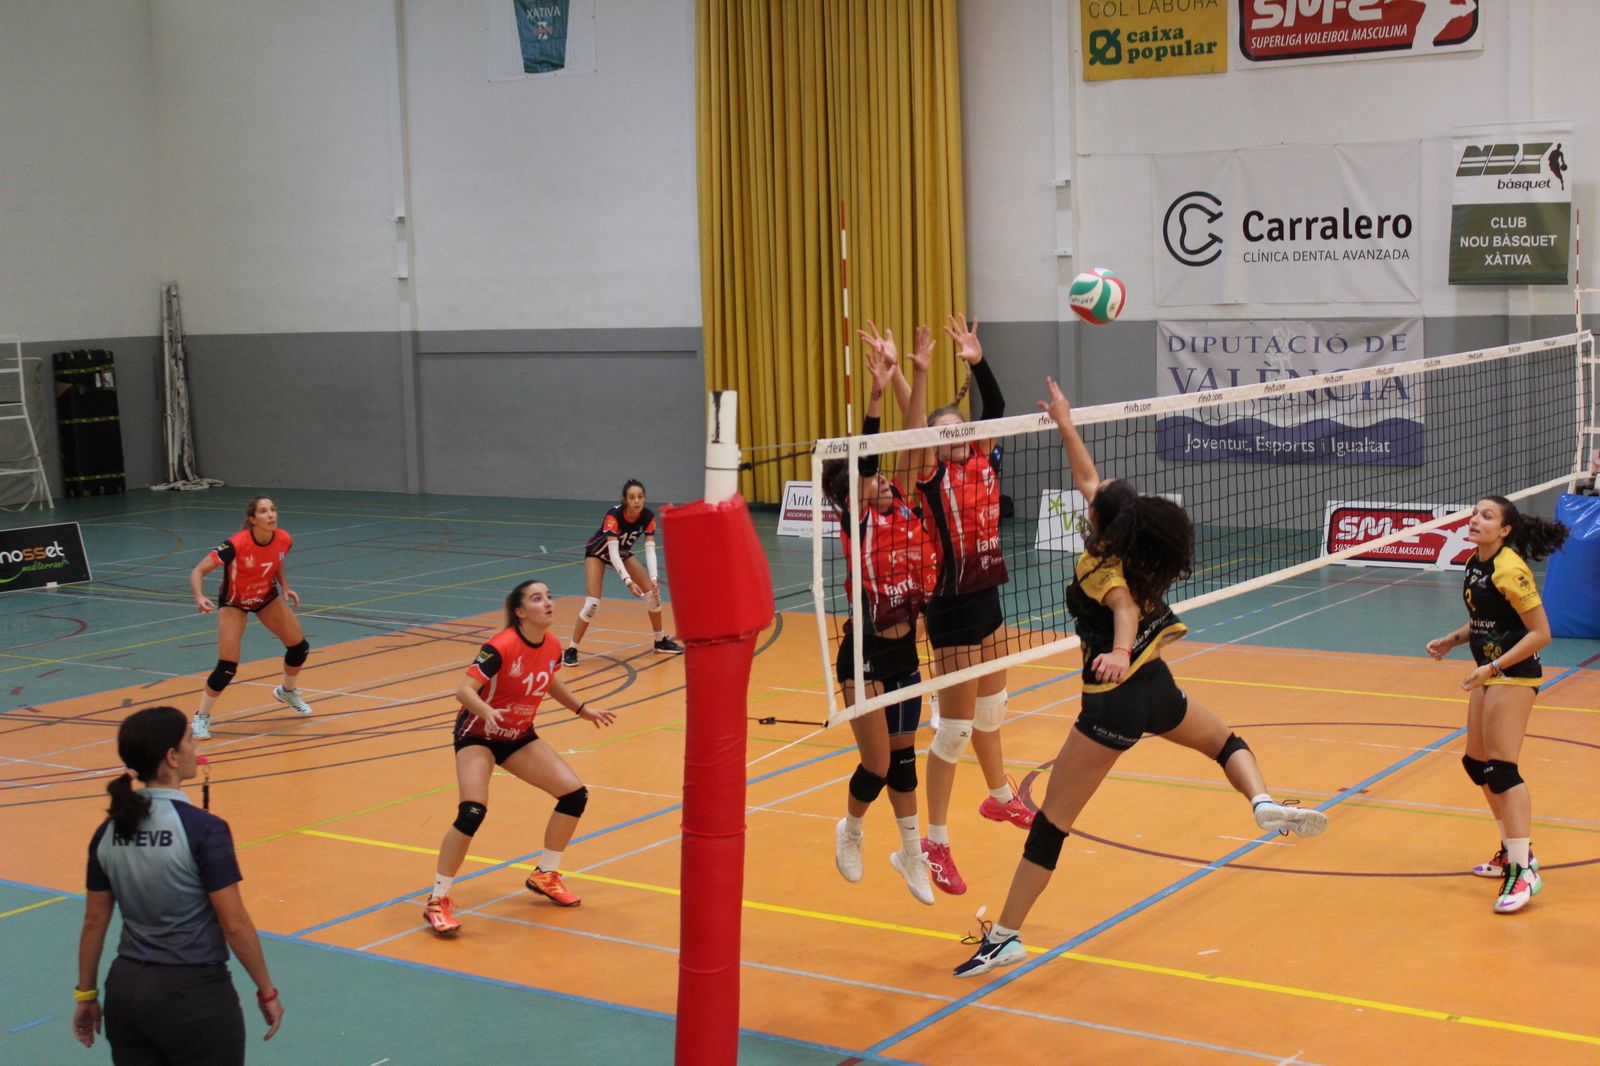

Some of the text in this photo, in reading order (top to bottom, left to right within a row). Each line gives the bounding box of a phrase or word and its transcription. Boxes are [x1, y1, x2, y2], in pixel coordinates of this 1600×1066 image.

[1126, 25, 1185, 43] caixa
[1251, 24, 1408, 49] SUPERLIGA VOLEIBOL MASCULINA
[1127, 40, 1218, 64] popular
[1497, 178, 1551, 192] bàsquet
[1242, 207, 1413, 243] Carralero
[1490, 216, 1527, 229] CLUB
[1460, 233, 1558, 248] NOU BÀSQUET
[1243, 248, 1410, 263] CLÍNICA DENTAL AVANZADA
[1484, 251, 1532, 266] XÀTIVA
[1168, 332, 1407, 354] DIPUTACIÓ DE
[939, 426, 976, 440] rfevb.com
[1185, 433, 1252, 453] Joventut,
[1256, 436, 1315, 458] Esports
[1331, 437, 1391, 457] Igualtat
[620, 531, 638, 546] 15
[1398, 546, 1435, 557] MASCULINA
[260, 562, 274, 578] 7
[521, 671, 550, 697] 12
[112, 830, 173, 847] REVB
